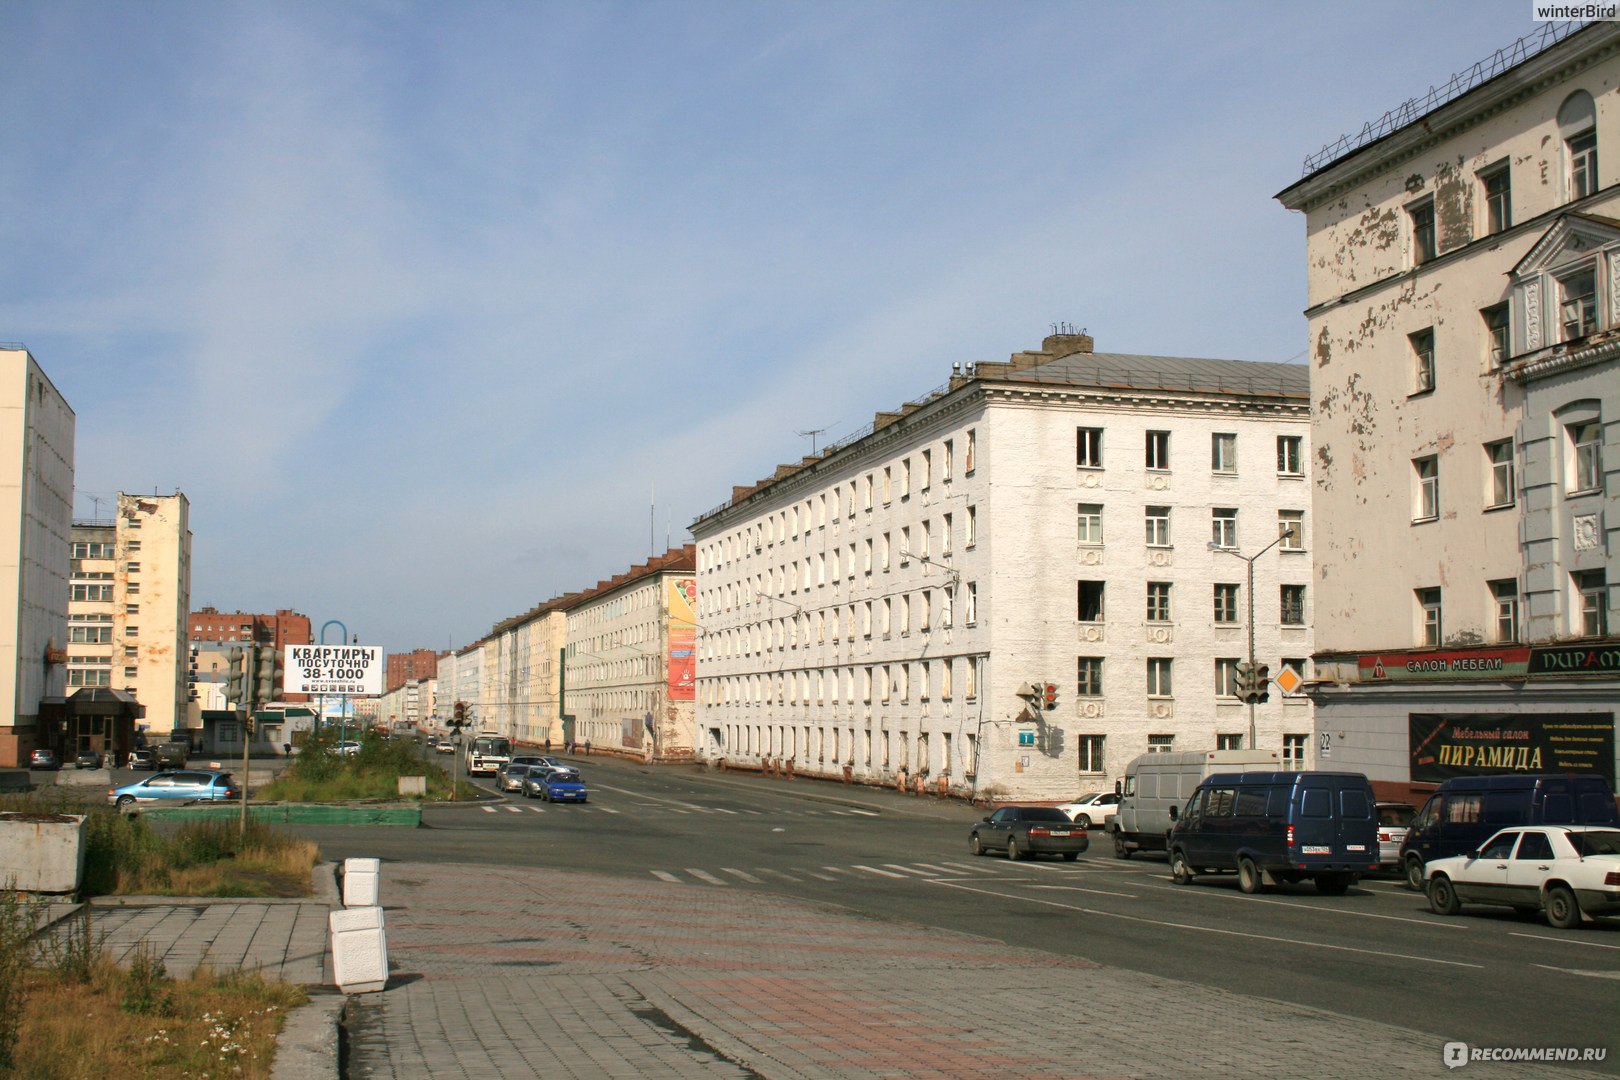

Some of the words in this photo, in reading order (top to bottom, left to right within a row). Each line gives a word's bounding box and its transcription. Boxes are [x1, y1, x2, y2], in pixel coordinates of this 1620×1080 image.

[293, 648, 375, 660] КВАРТИРЫ
[298, 659, 369, 668] ПОСУТОЧНО
[1406, 659, 1447, 673] САЛОН
[1452, 657, 1503, 671] МЕБЕЛИ
[302, 668, 364, 679] 38-1000
[1452, 726, 1501, 740] Мебельный
[1502, 729, 1529, 740] салон
[1321, 734, 1330, 750] 22
[1438, 744, 1543, 771] ПИРАМИДА
